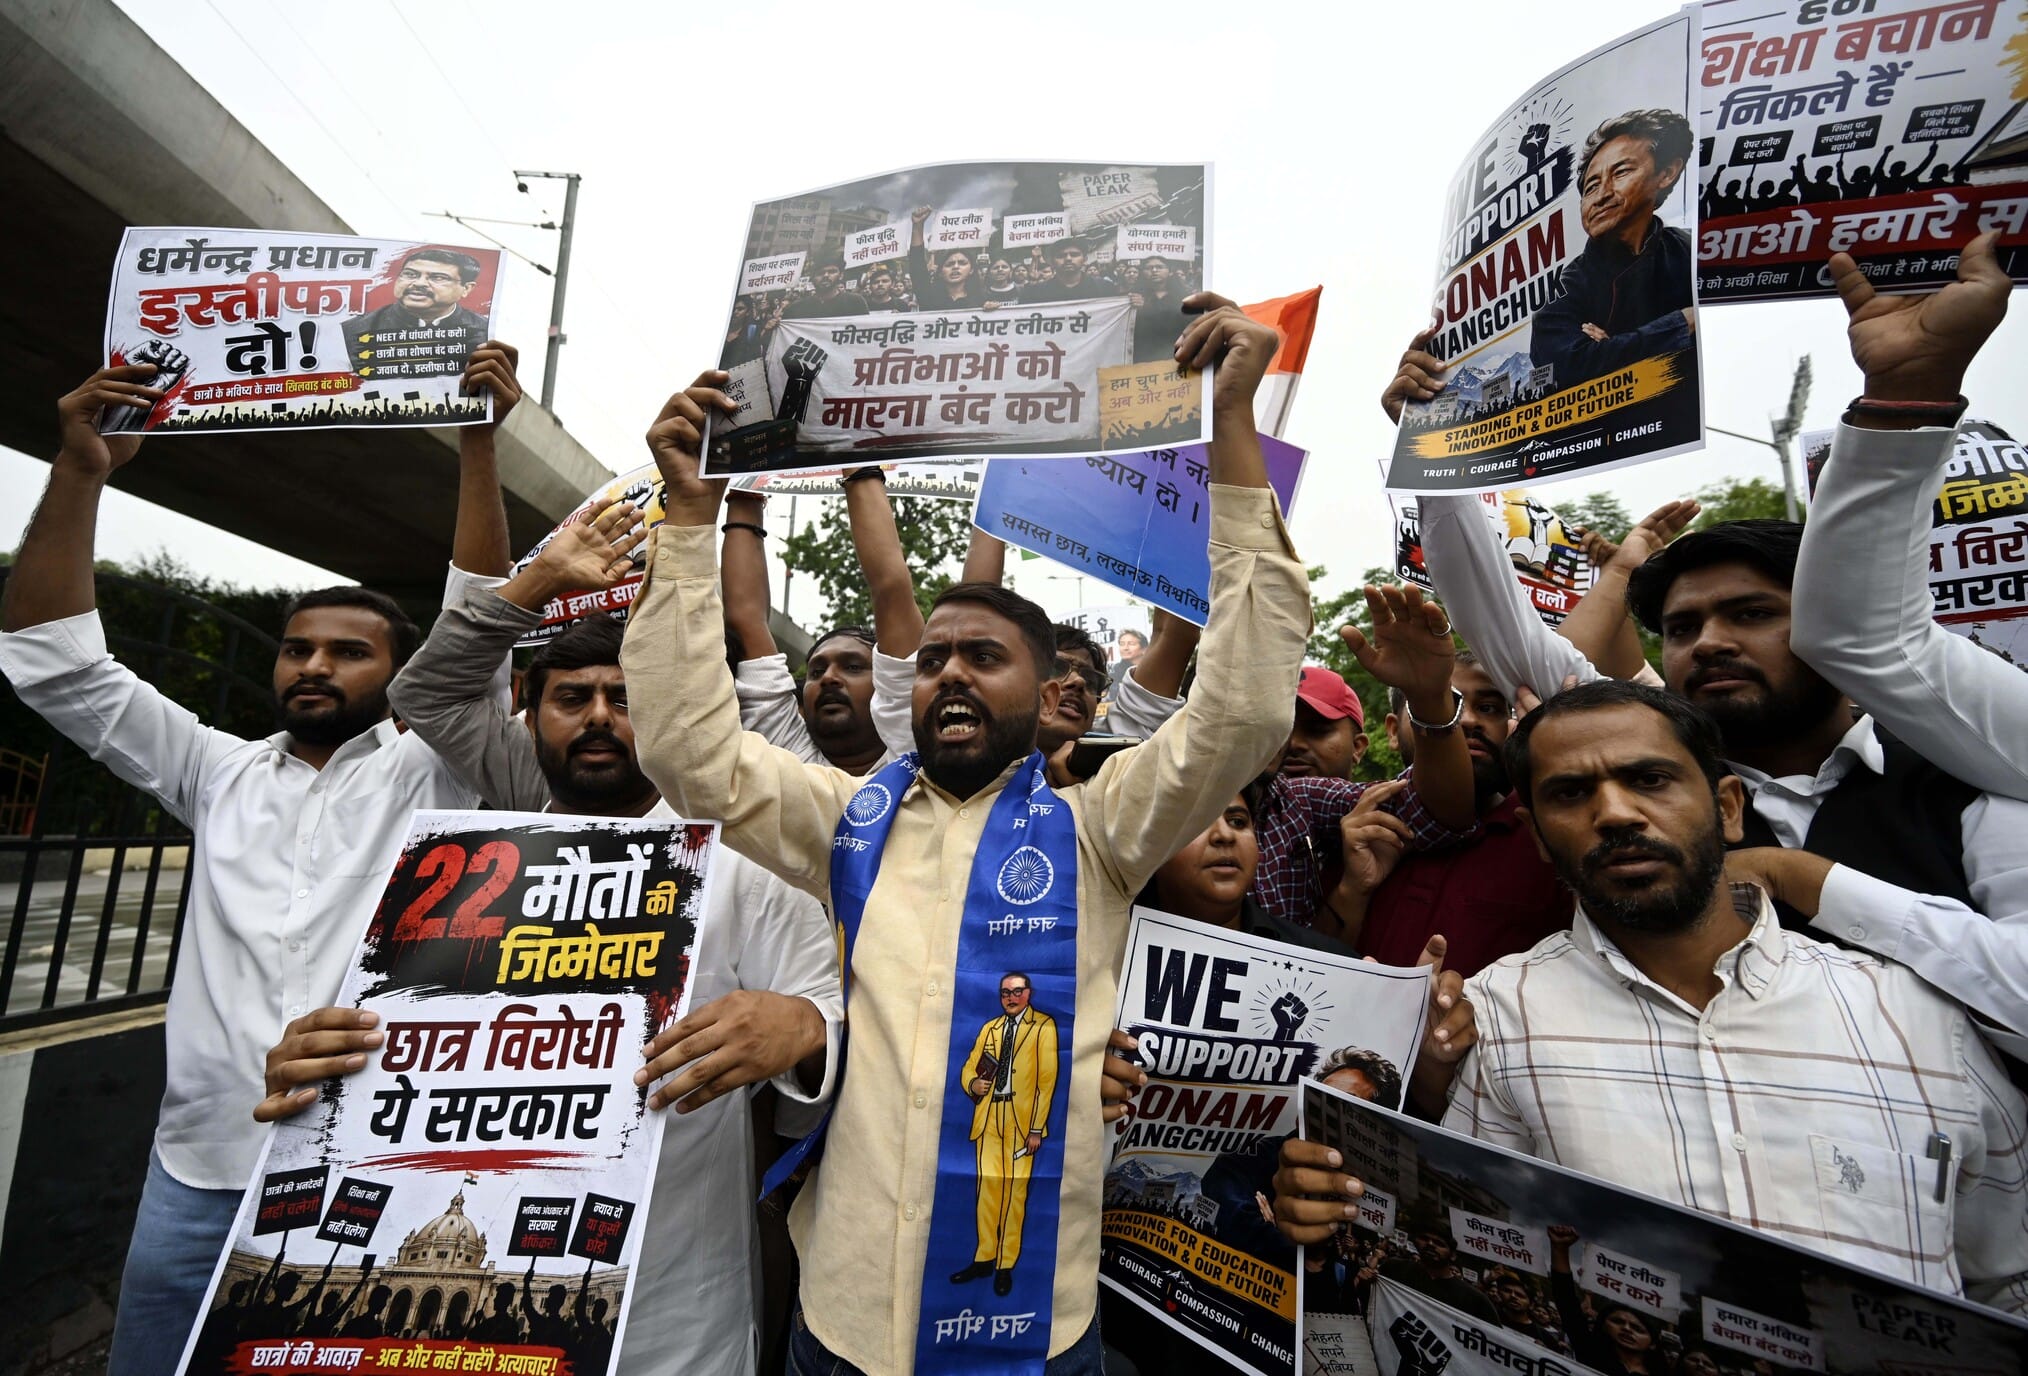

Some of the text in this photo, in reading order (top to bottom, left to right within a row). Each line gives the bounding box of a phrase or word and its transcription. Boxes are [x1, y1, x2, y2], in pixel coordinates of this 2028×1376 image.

[1716, 60, 1914, 131] निकले हैं
[1083, 172, 1131, 187] PAPER
[1086, 184, 1131, 197] LEAK
[1446, 137, 1498, 229] WE
[942, 213, 983, 227] पेपर लीक
[1441, 158, 1558, 272] SUPPORT
[1699, 209, 1821, 261] आओ
[1828, 193, 1969, 252] हमारे
[851, 241, 899, 261] नहीं चलेगी
[940, 227, 981, 242] बंद करो
[1128, 228, 1187, 240] योग्यता हमारी
[137, 238, 378, 275] धर्मेन्द्र प्रधान
[748, 257, 800, 273] शिक्षा पर हमला
[1431, 208, 1566, 334] SONAM
[1707, 275, 1721, 289] को
[1724, 273, 1754, 288] अच्छी
[1756, 270, 1789, 285] शिक्षा
[138, 271, 373, 336] इस्तीफा
[1426, 264, 1568, 361] WANGCHUK
[376, 326, 466, 342] NEET में धांधली बंद करो!
[831, 311, 1091, 347] फीसवृद्धि और पेपर लीक से
[225, 320, 318, 376] दो!
[376, 343, 466, 359] छात्रों का शोषण बंद करो!
[852, 341, 1066, 386] प्रतिभाओं को
[376, 360, 459, 376] जवाब दो, इस्तीफा दो!
[193, 387, 213, 401] छात्रों
[215, 386, 224, 399] के
[226, 383, 252, 398] भविष्य
[254, 382, 263, 395] के
[265, 383, 283, 395] साथ
[285, 379, 319, 394] खिलवाड़
[321, 377, 332, 390] बंद
[822, 382, 1086, 429] मारना बंद करो
[1444, 371, 1639, 443] STANDING FOR EDUCATION,
[1448, 387, 1635, 453] INNOVATION & OUR FUTURE
[1423, 420, 1663, 477] TRUTH COURAGE COMPASSION CHANGE
[1086, 455, 1147, 495] न्याय
[1156, 481, 1181, 513] दो
[1002, 511, 1210, 616] समस्त छात्र, लखनऊ विश्वविद्य
[1536, 588, 1568, 610] चलो
[392, 840, 679, 940] 22 मौतों की
[496, 923, 665, 984] जिम्मेदार
[1144, 944, 1249, 1032] WE
[381, 1002, 625, 1073] छात्र विरोधी
[1134, 1032, 1304, 1082] SUPPORT
[369, 1074, 612, 1144] ये सरकार
[1115, 1085, 1288, 1135] SONAM
[265, 1176, 325, 1196] छात्रों की अनदेखी
[347, 1185, 381, 1202] शिक्षा नहीं
[261, 1195, 321, 1220] नहीं चलेगी
[527, 1220, 558, 1231] सरकार
[593, 1202, 624, 1219] न्याय दो
[1362, 1206, 1386, 1226] नहीं
[326, 1220, 369, 1238] नहीं चलेगा
[1101, 1212, 1288, 1296] STANDING FOR EDUCATION,
[1101, 1223, 1281, 1309] INNOVATION & OUR FUTURE
[1464, 1234, 1533, 1265] नहीं चलेगी
[1596, 1252, 1666, 1288] पेपर लीक
[1595, 1272, 1663, 1308] बंद करो
[1118, 1255, 1295, 1366] COURAGE COMPASSION CHANGE
[1716, 1307, 1759, 1331] हमारा
[1852, 1293, 1959, 1337] PAPER
[1309, 1330, 1344, 1344] मेहनत
[1319, 1344, 1345, 1359] सपने
[1711, 1322, 1814, 1367] बेचना बंद करो
[1858, 1312, 1953, 1355] LEAK
[250, 1342, 291, 1368] छात्रों
[290, 1341, 314, 1366] की
[313, 1346, 364, 1371] आवाज़
[376, 1348, 405, 1369] अब
[402, 1344, 433, 1369] और
[432, 1345, 465, 1371] नहीं
[462, 1347, 496, 1372] सहेंगे
[495, 1353, 558, 1376] अत्याचार!
